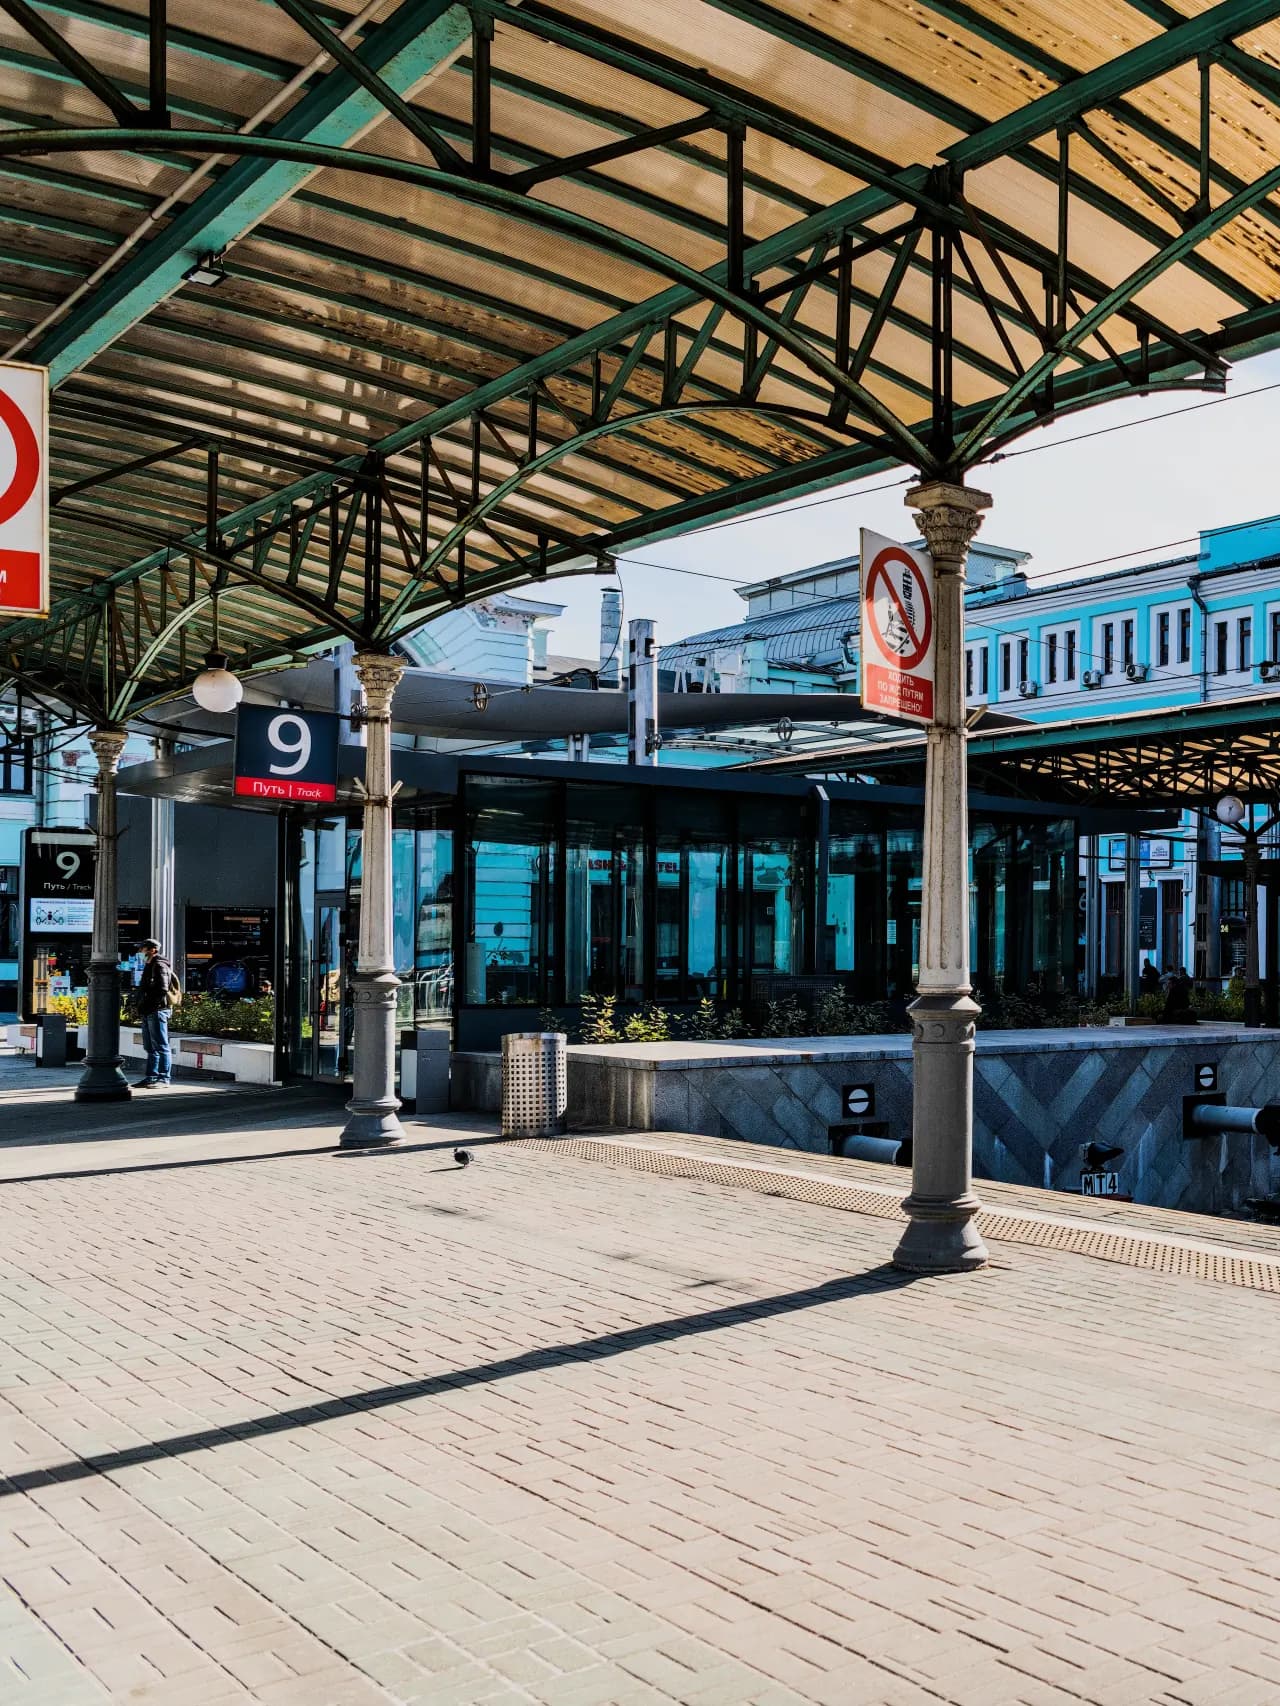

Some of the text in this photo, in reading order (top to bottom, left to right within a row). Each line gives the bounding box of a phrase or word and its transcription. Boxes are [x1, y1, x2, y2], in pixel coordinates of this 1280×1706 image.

[888, 671, 914, 686] ХОДИТЬ
[877, 680, 888, 691] ПО
[903, 687, 924, 701] ПУТЯМ
[267, 714, 312, 775] 9
[253, 781, 285, 796] Путь
[296, 787, 323, 798] Track
[56, 851, 80, 880] 9
[43, 882, 66, 891] Путь
